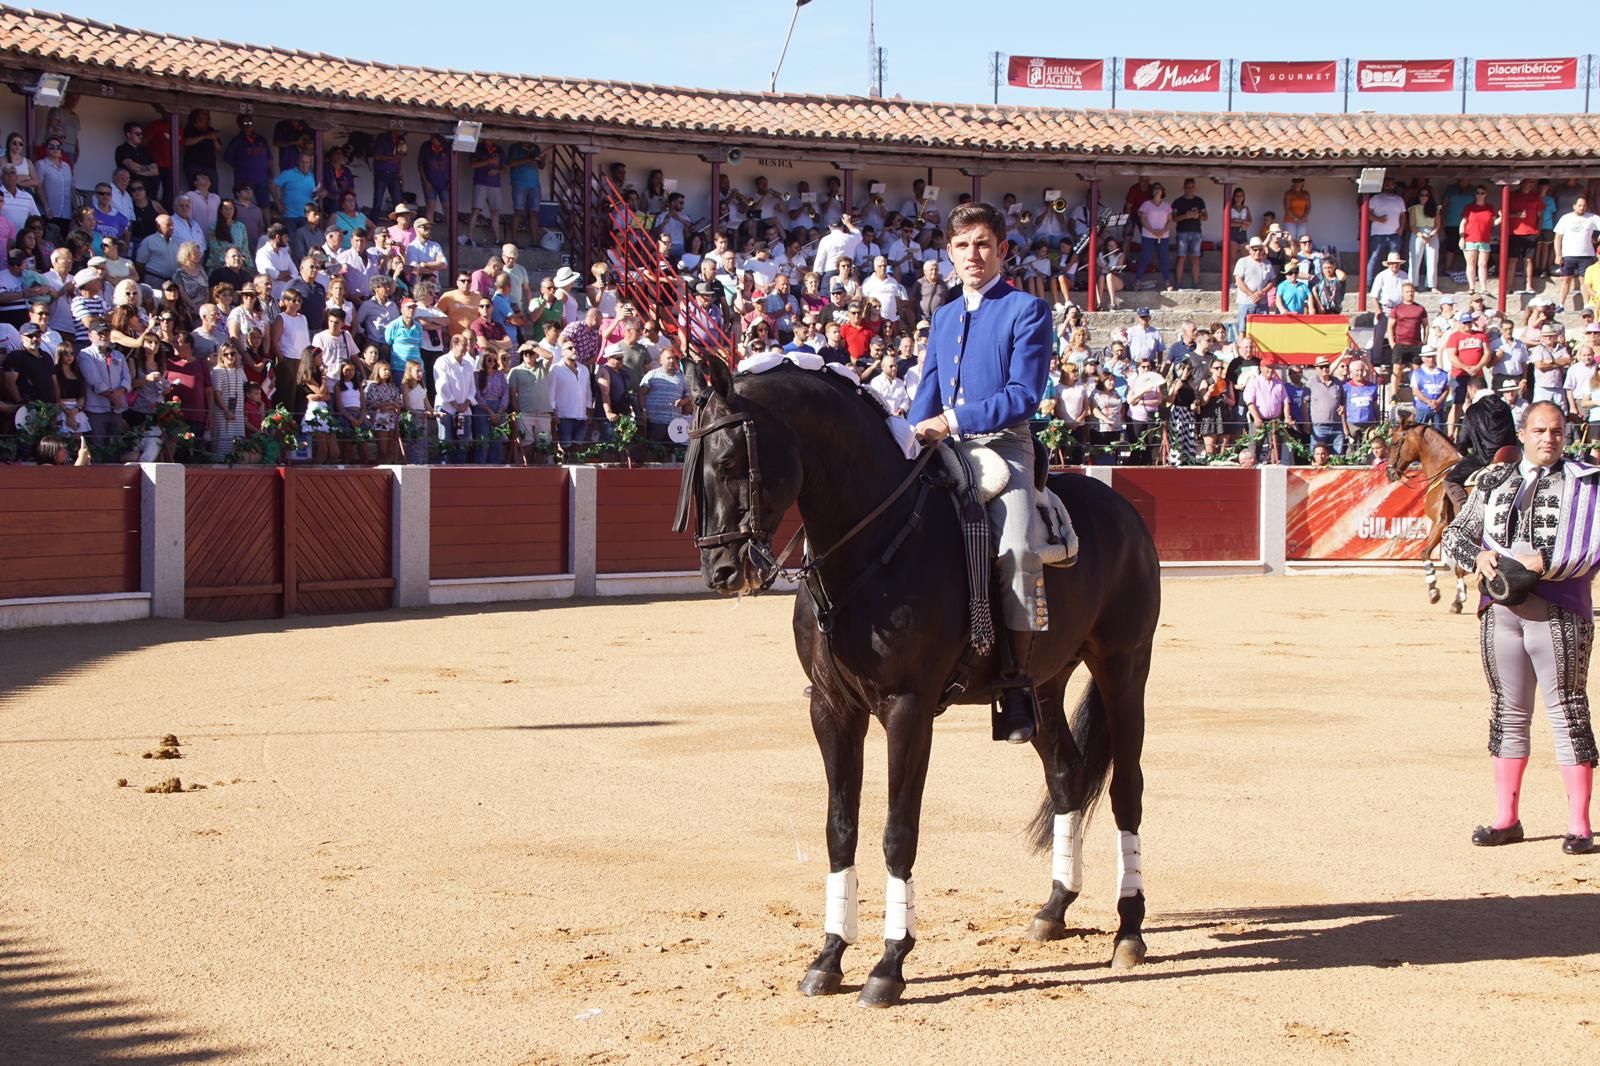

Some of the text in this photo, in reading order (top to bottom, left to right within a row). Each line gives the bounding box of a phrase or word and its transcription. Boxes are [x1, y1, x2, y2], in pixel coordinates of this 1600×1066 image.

[1046, 65, 1075, 76] JULIÁN
[1158, 65, 1212, 90] Marcial
[1269, 73, 1331, 81] GOURMET
